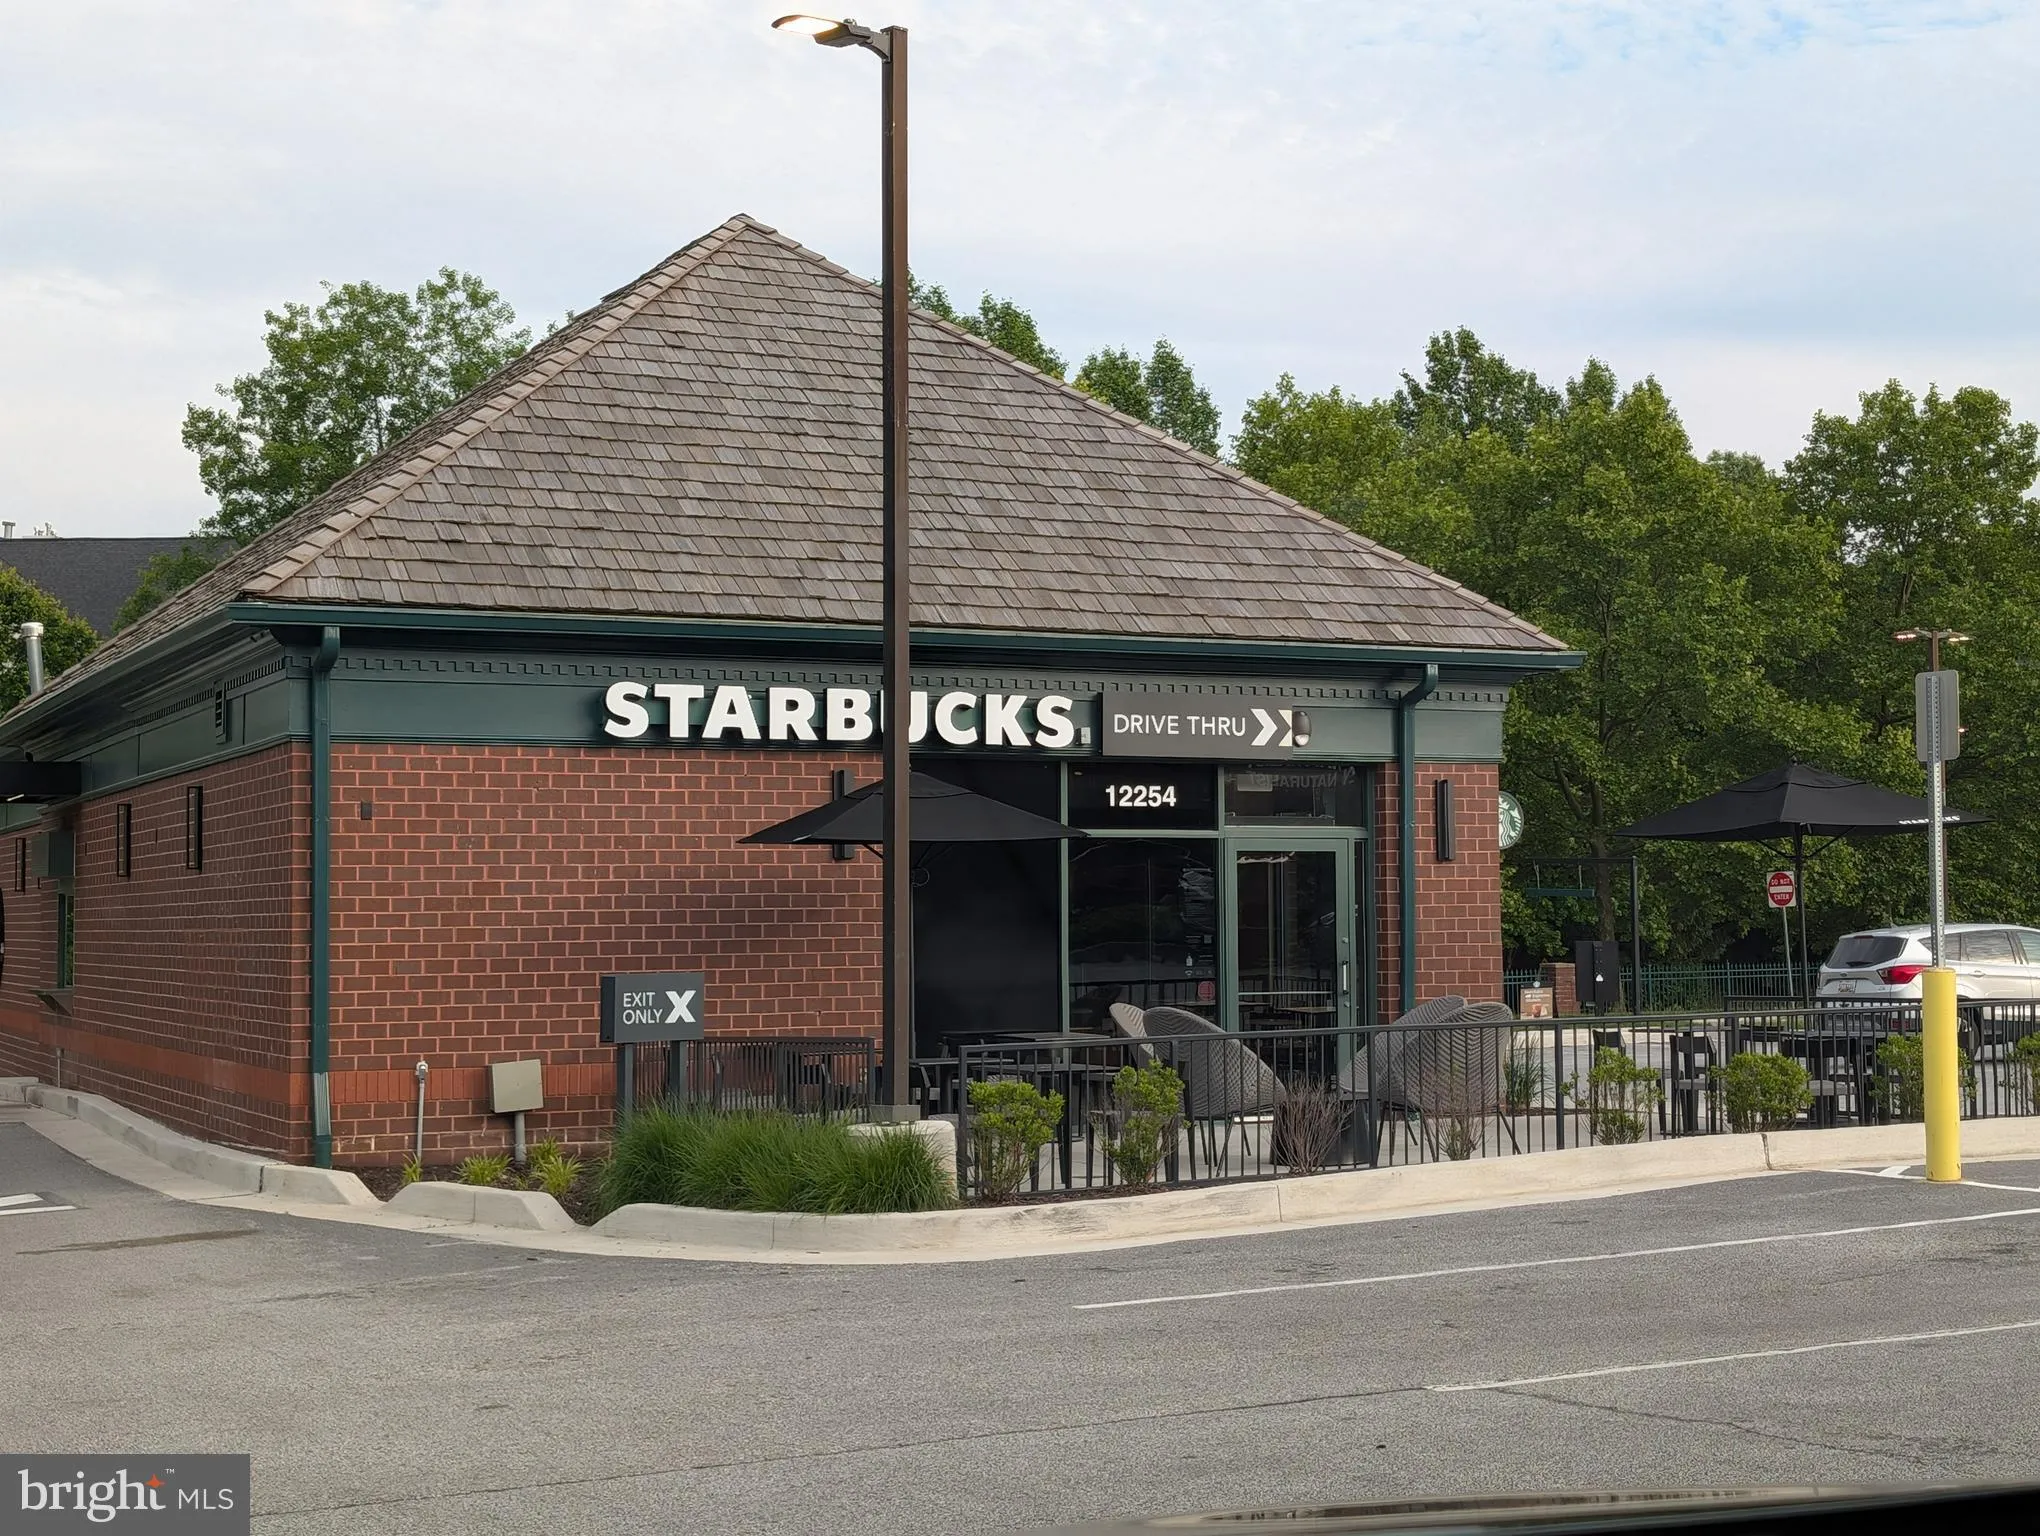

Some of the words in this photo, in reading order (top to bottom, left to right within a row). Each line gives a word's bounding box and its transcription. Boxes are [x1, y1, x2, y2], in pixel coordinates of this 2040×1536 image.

[1113, 714, 1179, 735] DRIVE
[1187, 716, 1247, 737] THRU
[1105, 785, 1177, 807] 12254
[623, 992, 655, 1007] EXIT
[622, 1008, 663, 1024] ONLY
